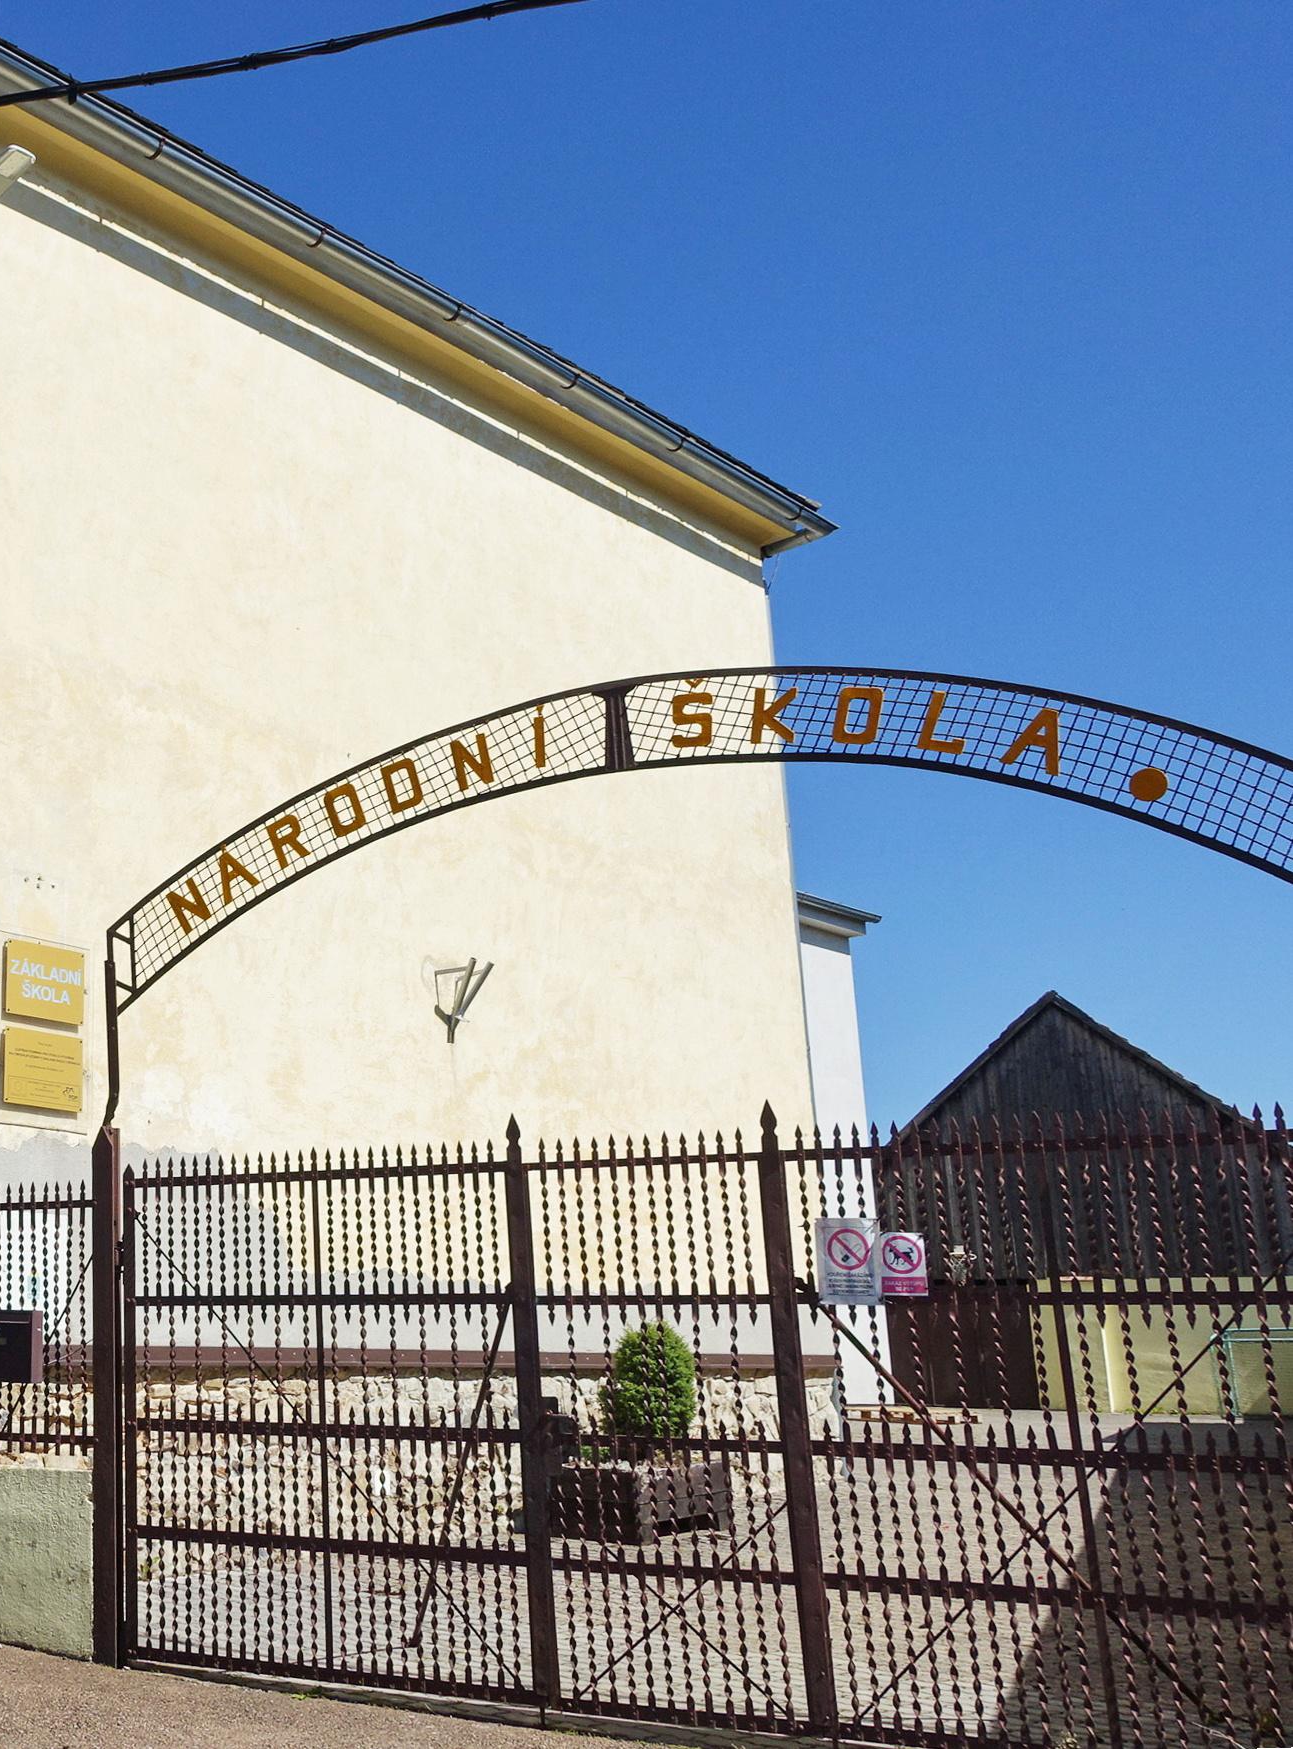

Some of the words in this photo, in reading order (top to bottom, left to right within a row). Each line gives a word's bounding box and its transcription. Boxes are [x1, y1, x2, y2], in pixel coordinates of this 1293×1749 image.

[166, 704, 546, 935] NÁRODNÍ
[671, 677, 1061, 777] ŠKOLA
[10, 958, 82, 986] ZÁKLADNÍ
[22, 980, 70, 1006] ŠKOLA
